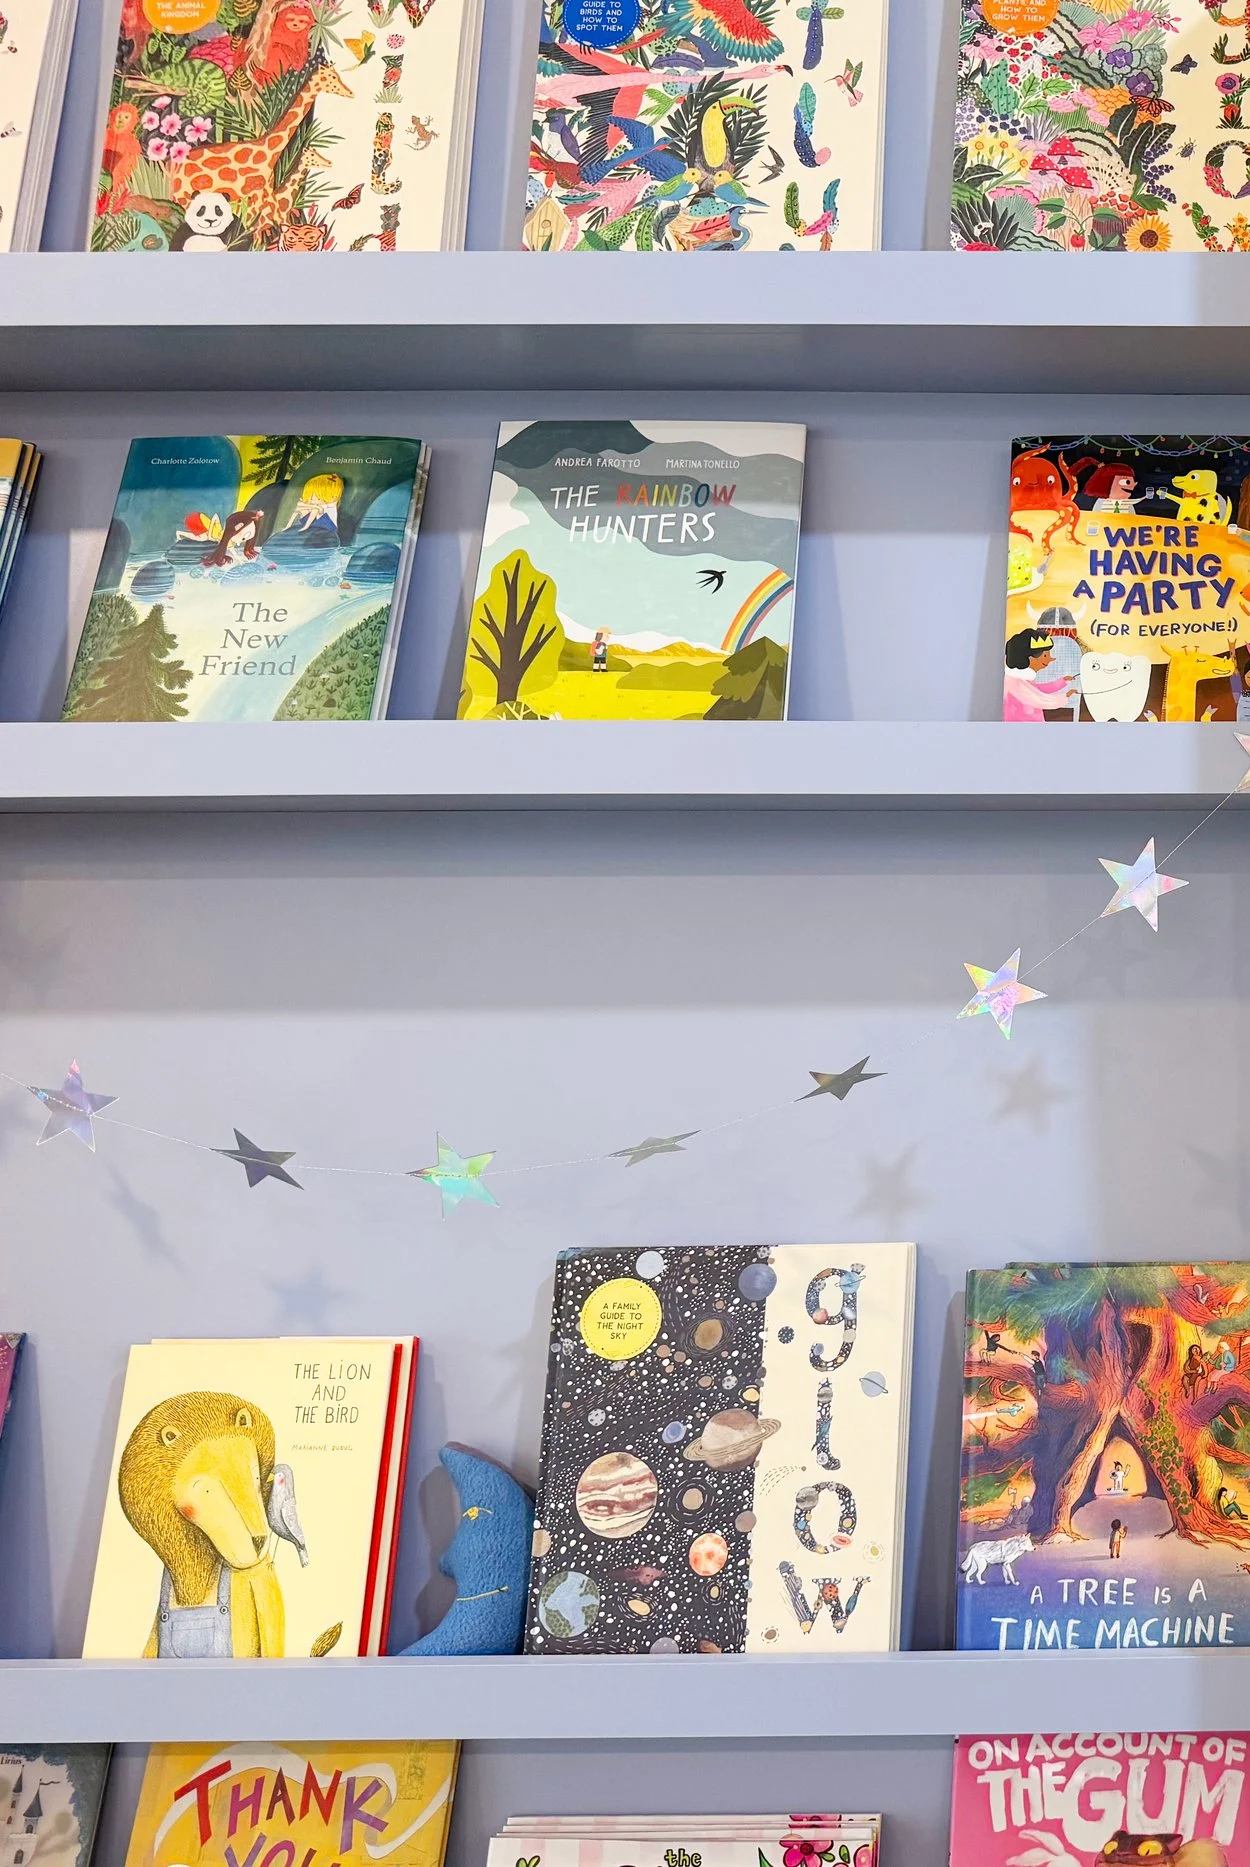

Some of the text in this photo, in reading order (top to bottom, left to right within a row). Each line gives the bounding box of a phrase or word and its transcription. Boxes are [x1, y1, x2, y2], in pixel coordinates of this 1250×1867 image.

[151, 456, 220, 465] Charlotte Zolotow
[326, 456, 392, 466] Benjamin Chaud
[554, 457, 593, 467] ANDREA
[665, 458, 740, 469] MARTINA TONELLO
[550, 483, 736, 509] THE RAINBOW
[569, 512, 716, 544] HUNTERS
[1103, 525, 1199, 548] WE'RE
[1089, 550, 1222, 577] HAVING
[1072, 577, 1236, 615] A PARTY
[232, 602, 288, 623] The
[1139, 617, 1238, 636] EVERYONE!)
[220, 628, 289, 650] New
[198, 654, 297, 677] Friend
[600, 1312, 625, 1320] GUIDE
[617, 1322, 643, 1330] NIGHT
[610, 1332, 627, 1340] SKY
[294, 1363, 320, 1379] THE
[312, 1384, 346, 1401] AND
[295, 1405, 319, 1423] THE
[1030, 1577, 1208, 1606] A TREE IS A
[991, 1612, 1234, 1650] TIME MACHINE
[968, 1733, 1247, 1770] ON ACCOUNT OF
[173, 1759, 389, 1856] THANK
[976, 1756, 1245, 1853] THE GUM
[664, 1848, 702, 1867] the
